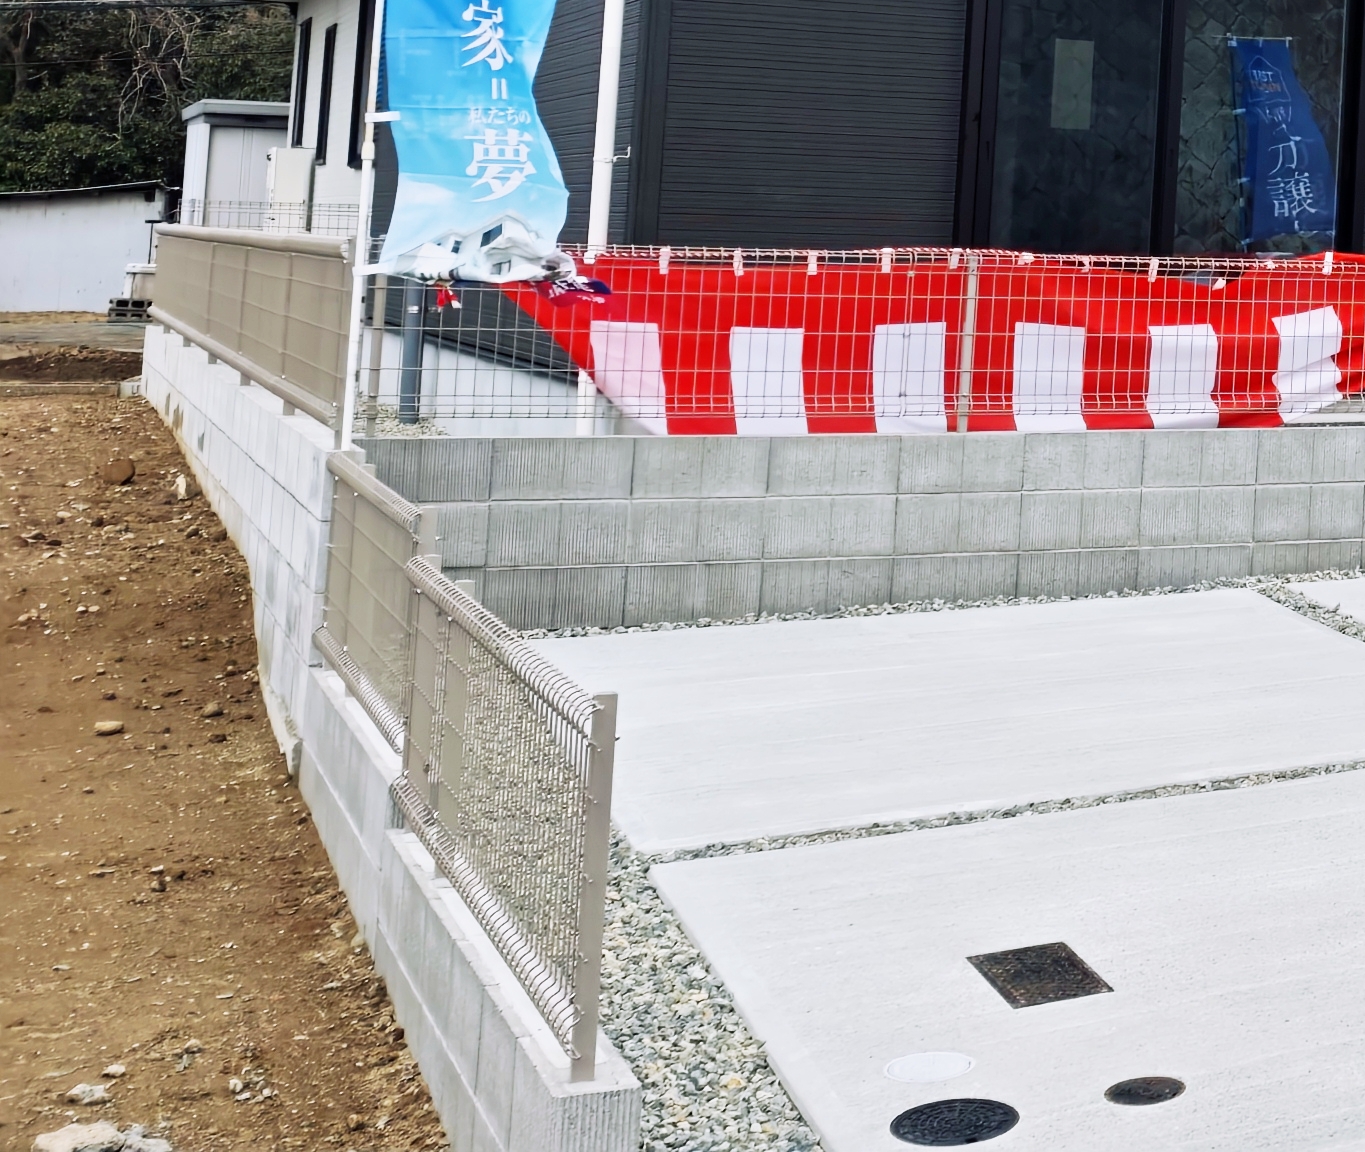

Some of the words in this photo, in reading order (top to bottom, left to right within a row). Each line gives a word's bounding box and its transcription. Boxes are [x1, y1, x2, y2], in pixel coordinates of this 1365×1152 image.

[468, 107, 532, 126] 私たちの
[463, 128, 537, 203] 夢
